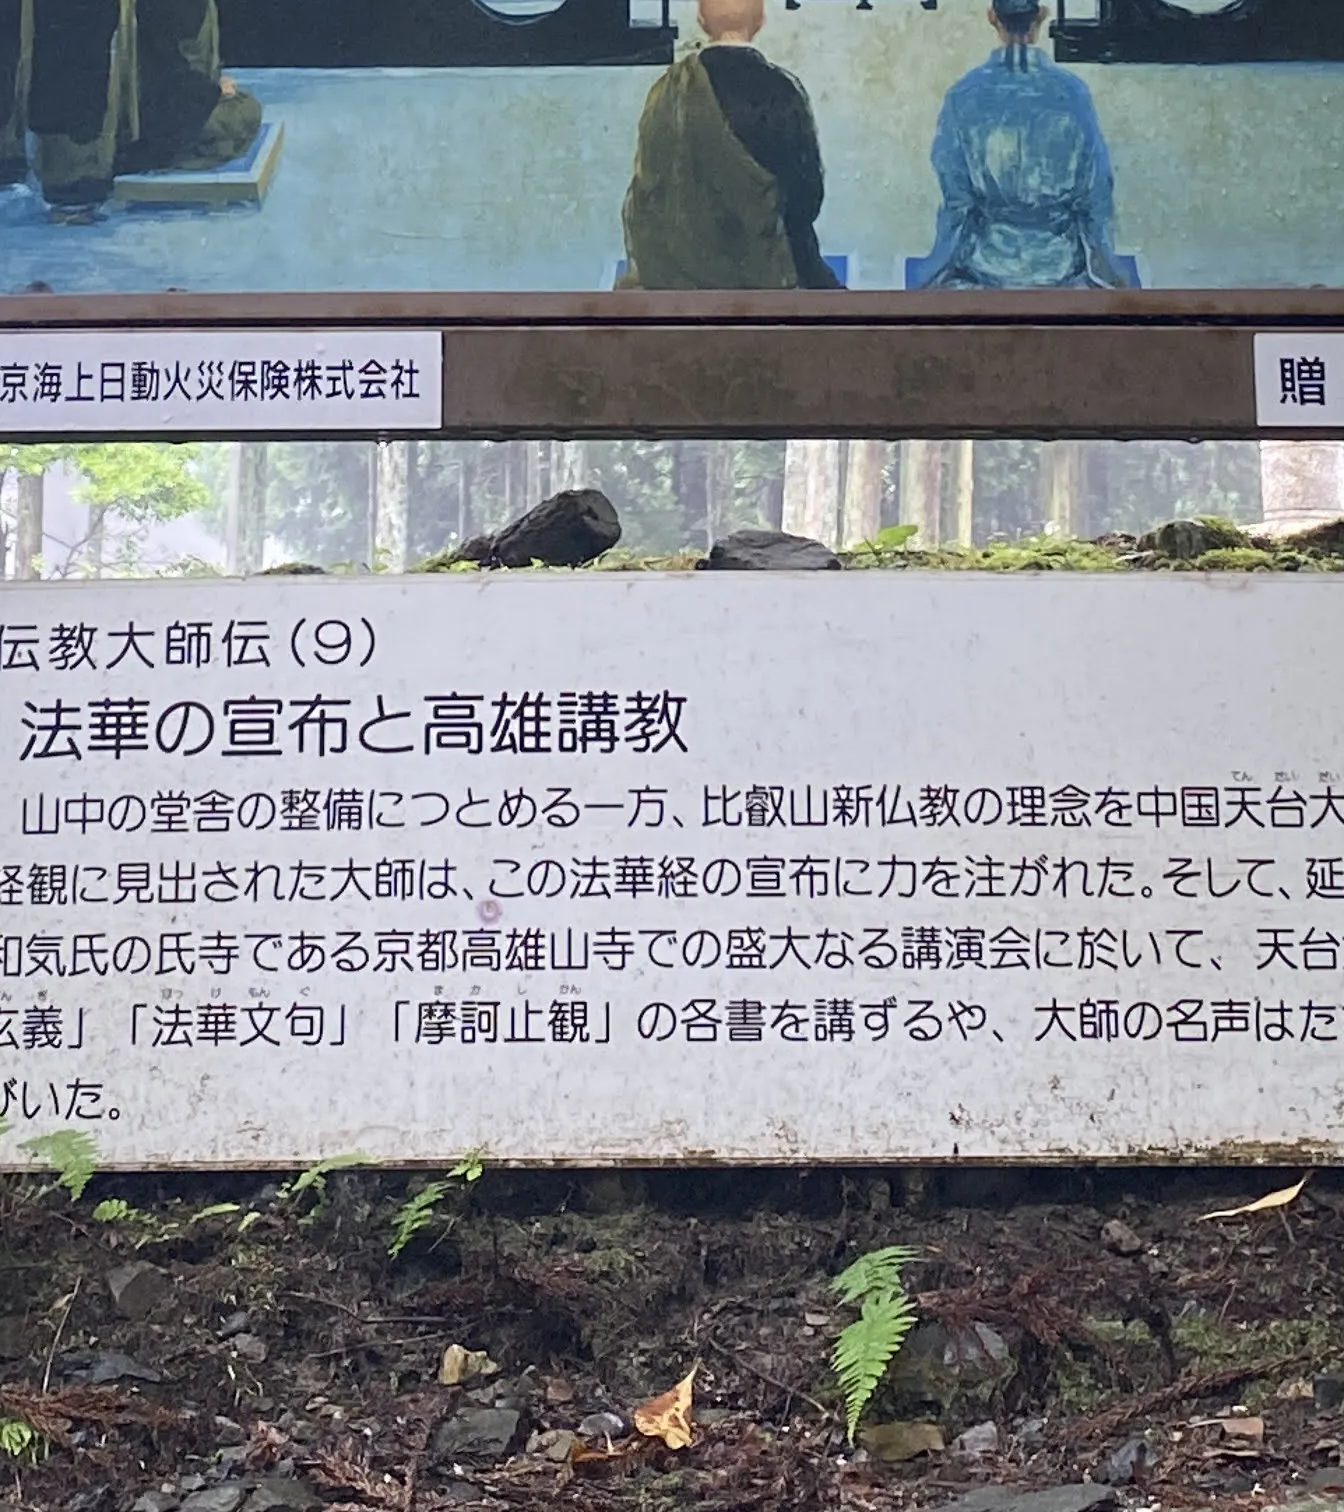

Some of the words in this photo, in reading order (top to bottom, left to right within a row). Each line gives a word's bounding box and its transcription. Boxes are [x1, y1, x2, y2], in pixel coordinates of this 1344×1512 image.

[1279, 356, 1326, 406] 贈
[19, 689, 688, 761] 法華の宣布と高雄講教
